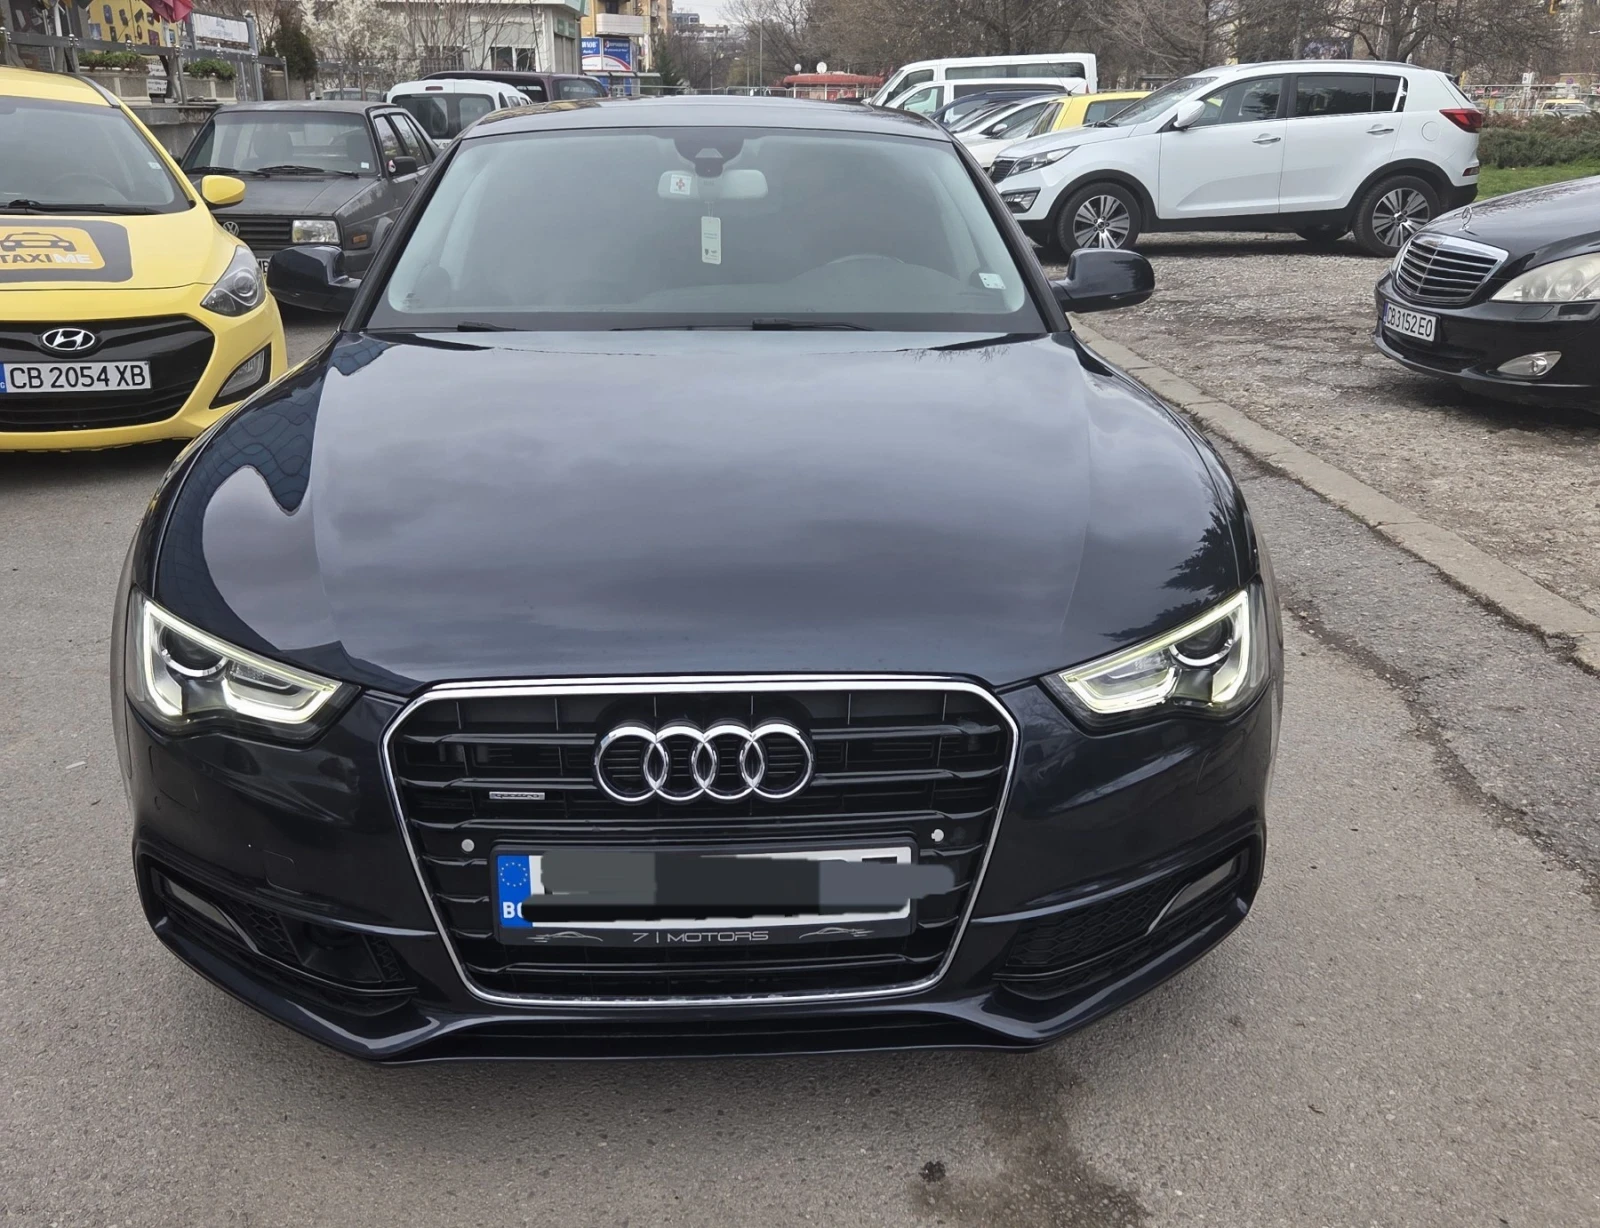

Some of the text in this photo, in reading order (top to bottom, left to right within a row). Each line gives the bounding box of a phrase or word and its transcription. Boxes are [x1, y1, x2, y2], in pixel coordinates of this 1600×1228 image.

[9, 364, 146, 389] CB 2054 XB
[667, 931, 769, 942] MOTORS
